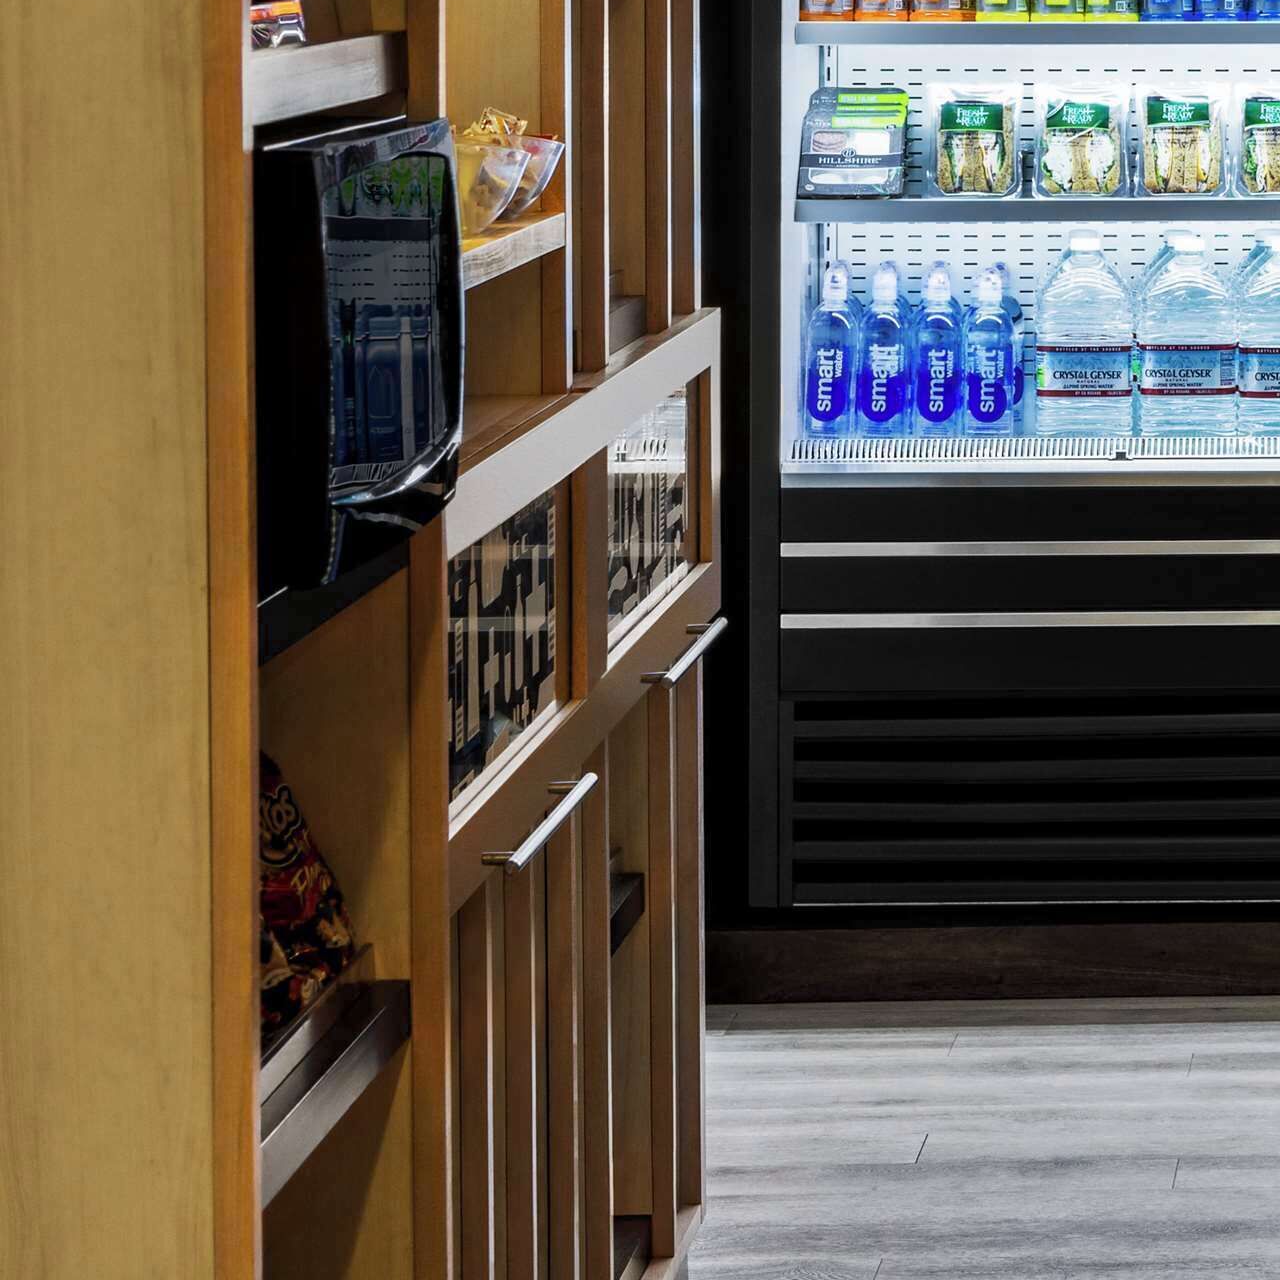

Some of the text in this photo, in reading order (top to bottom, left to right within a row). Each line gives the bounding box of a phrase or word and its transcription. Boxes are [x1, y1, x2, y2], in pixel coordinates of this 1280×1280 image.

[835, 349, 843, 378] water
[946, 349, 954, 378] water
[1053, 370, 1122, 380] CRYSTAL GEYSER
[1144, 369, 1212, 379] CRYSTAL GEYSER
[817, 348, 835, 412] smart
[928, 348, 946, 413] smart
[979, 348, 997, 413] smart
